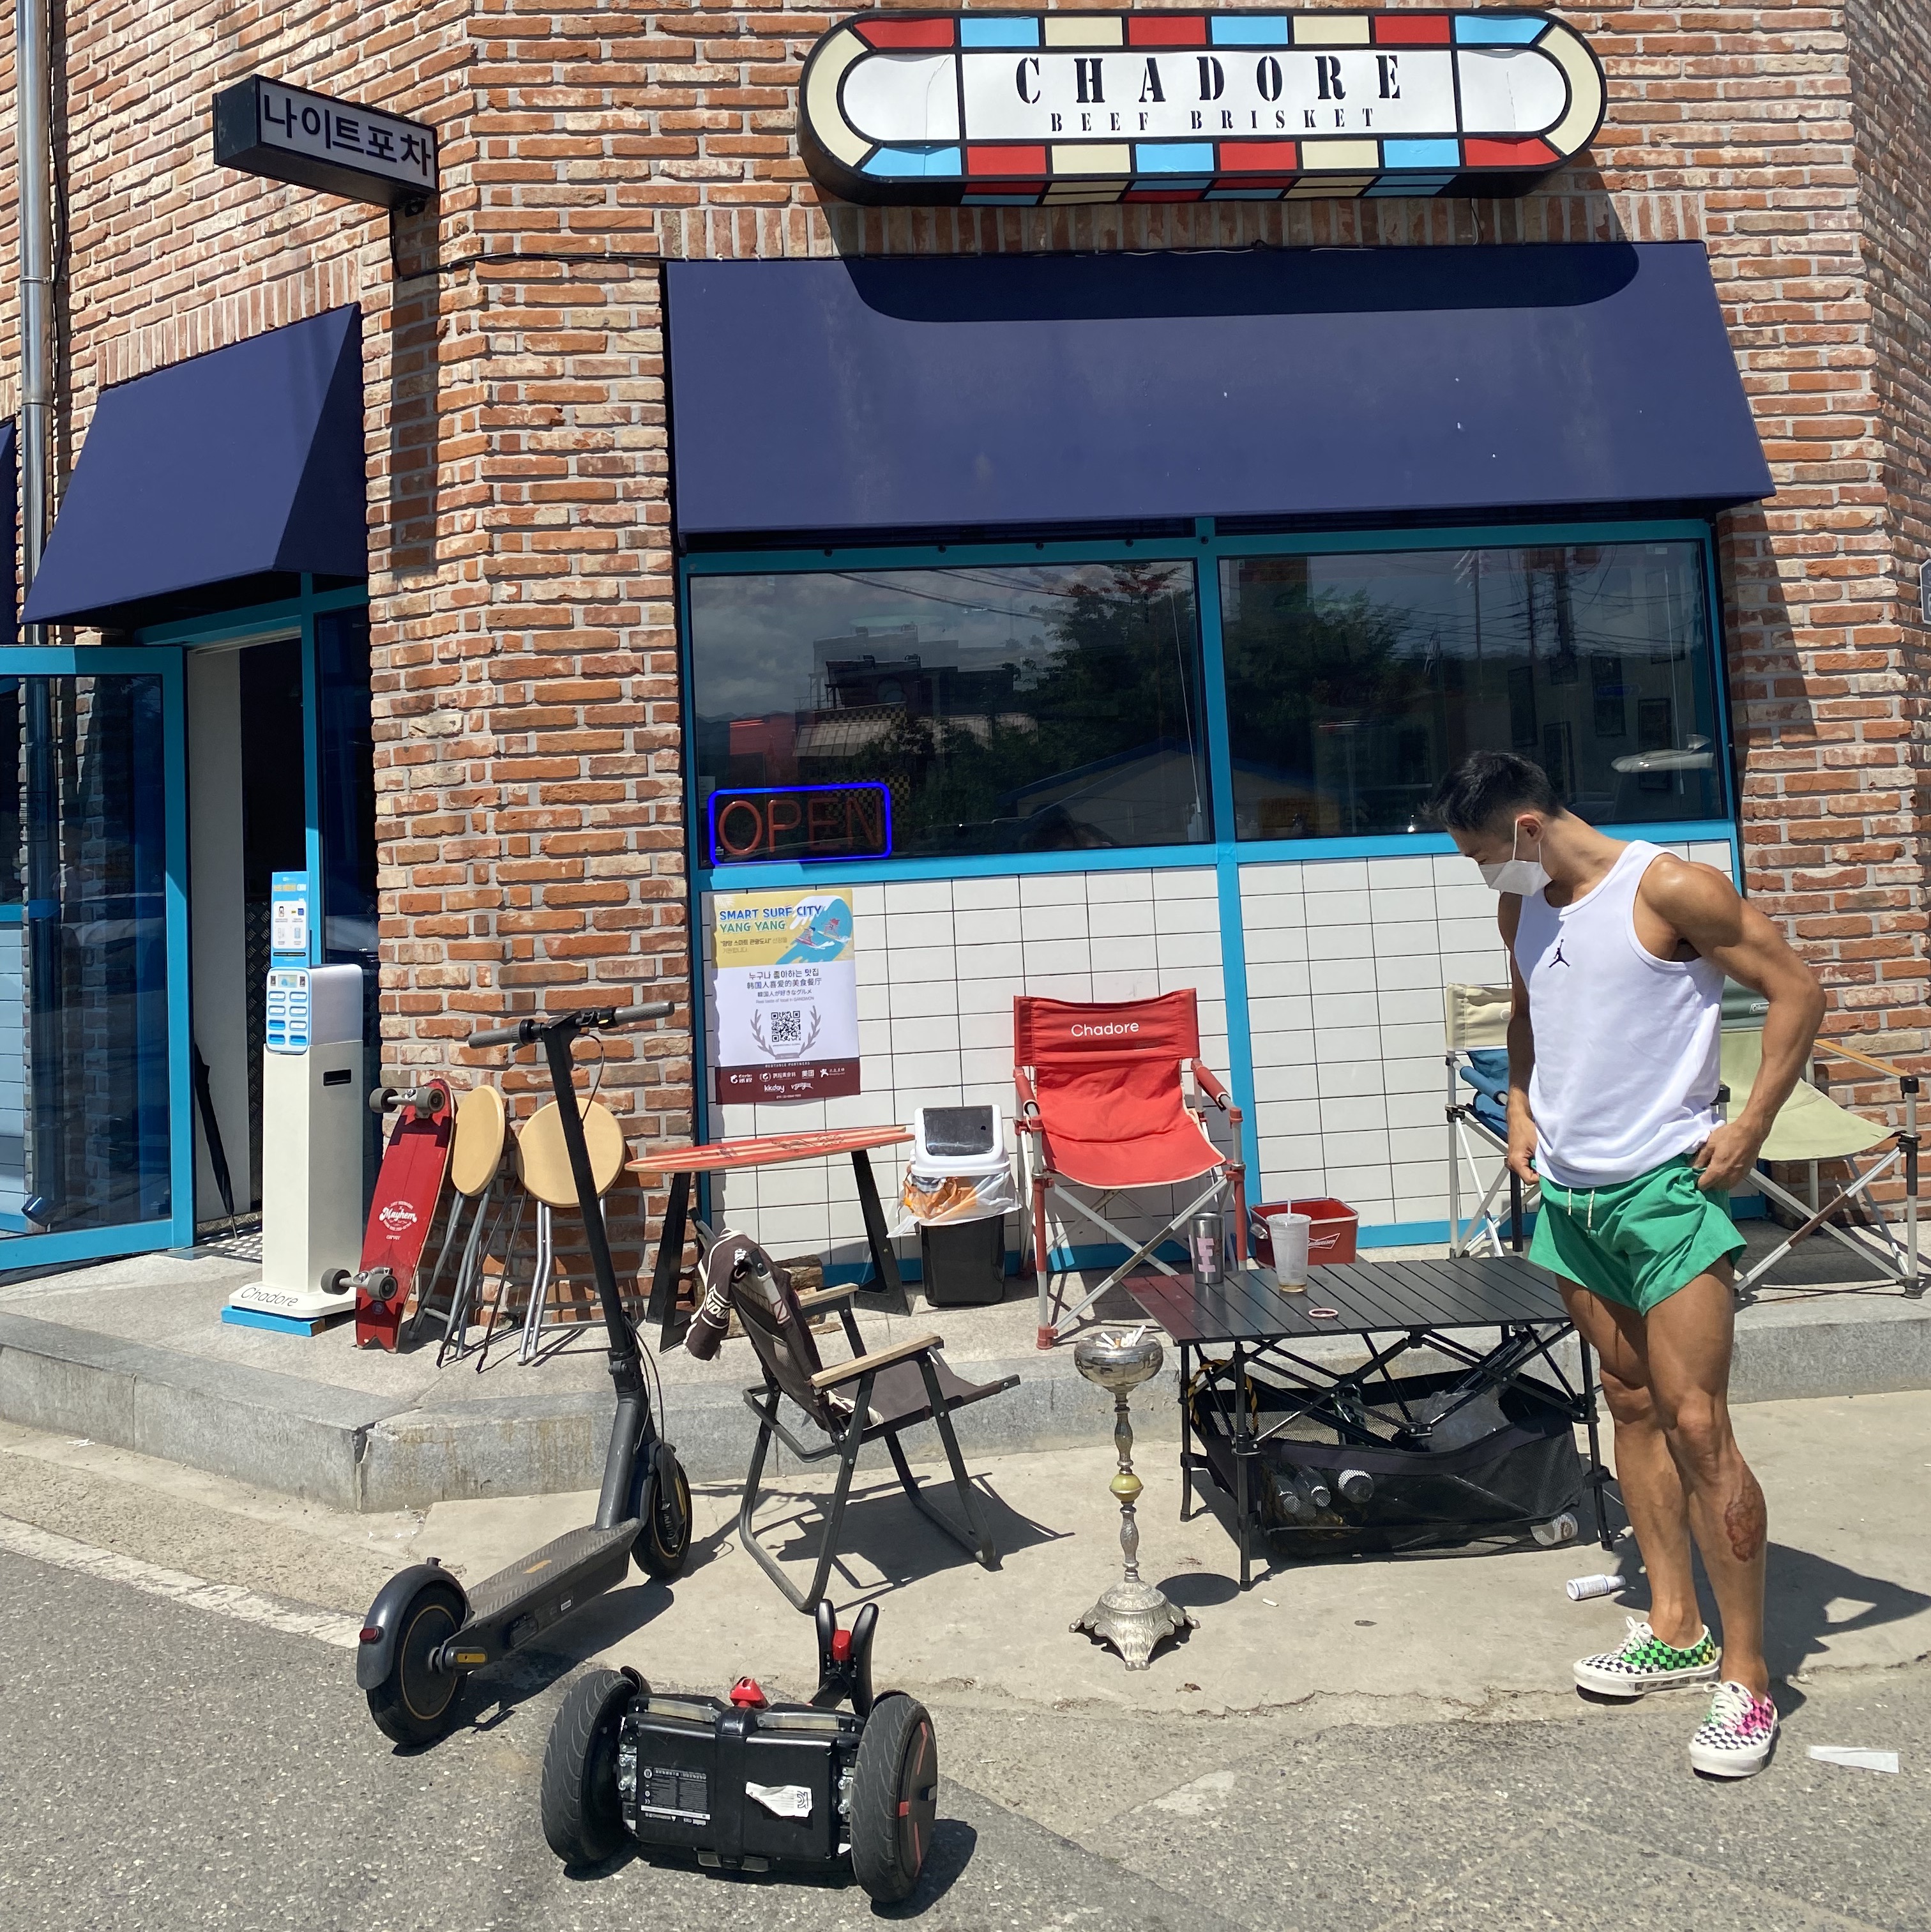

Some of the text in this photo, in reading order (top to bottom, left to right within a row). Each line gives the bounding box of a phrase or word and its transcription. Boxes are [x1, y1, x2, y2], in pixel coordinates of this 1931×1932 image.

[1016, 55, 1401, 104] CHADORE
[1050, 108, 1374, 132] BEEF BRISKET
[264, 95, 432, 176] 나이트포차
[718, 797, 883, 856] OPEN
[720, 906, 822, 920] SMART SURF CITY
[720, 920, 786, 933] YANG YANG
[749, 968, 819, 980] 누구나 좋아하는 맛집
[1071, 1022, 1139, 1037] Chadore
[764, 1084, 785, 1093] kkday
[379, 1206, 417, 1222] Mayhem
[241, 1288, 298, 1307] Chadore
